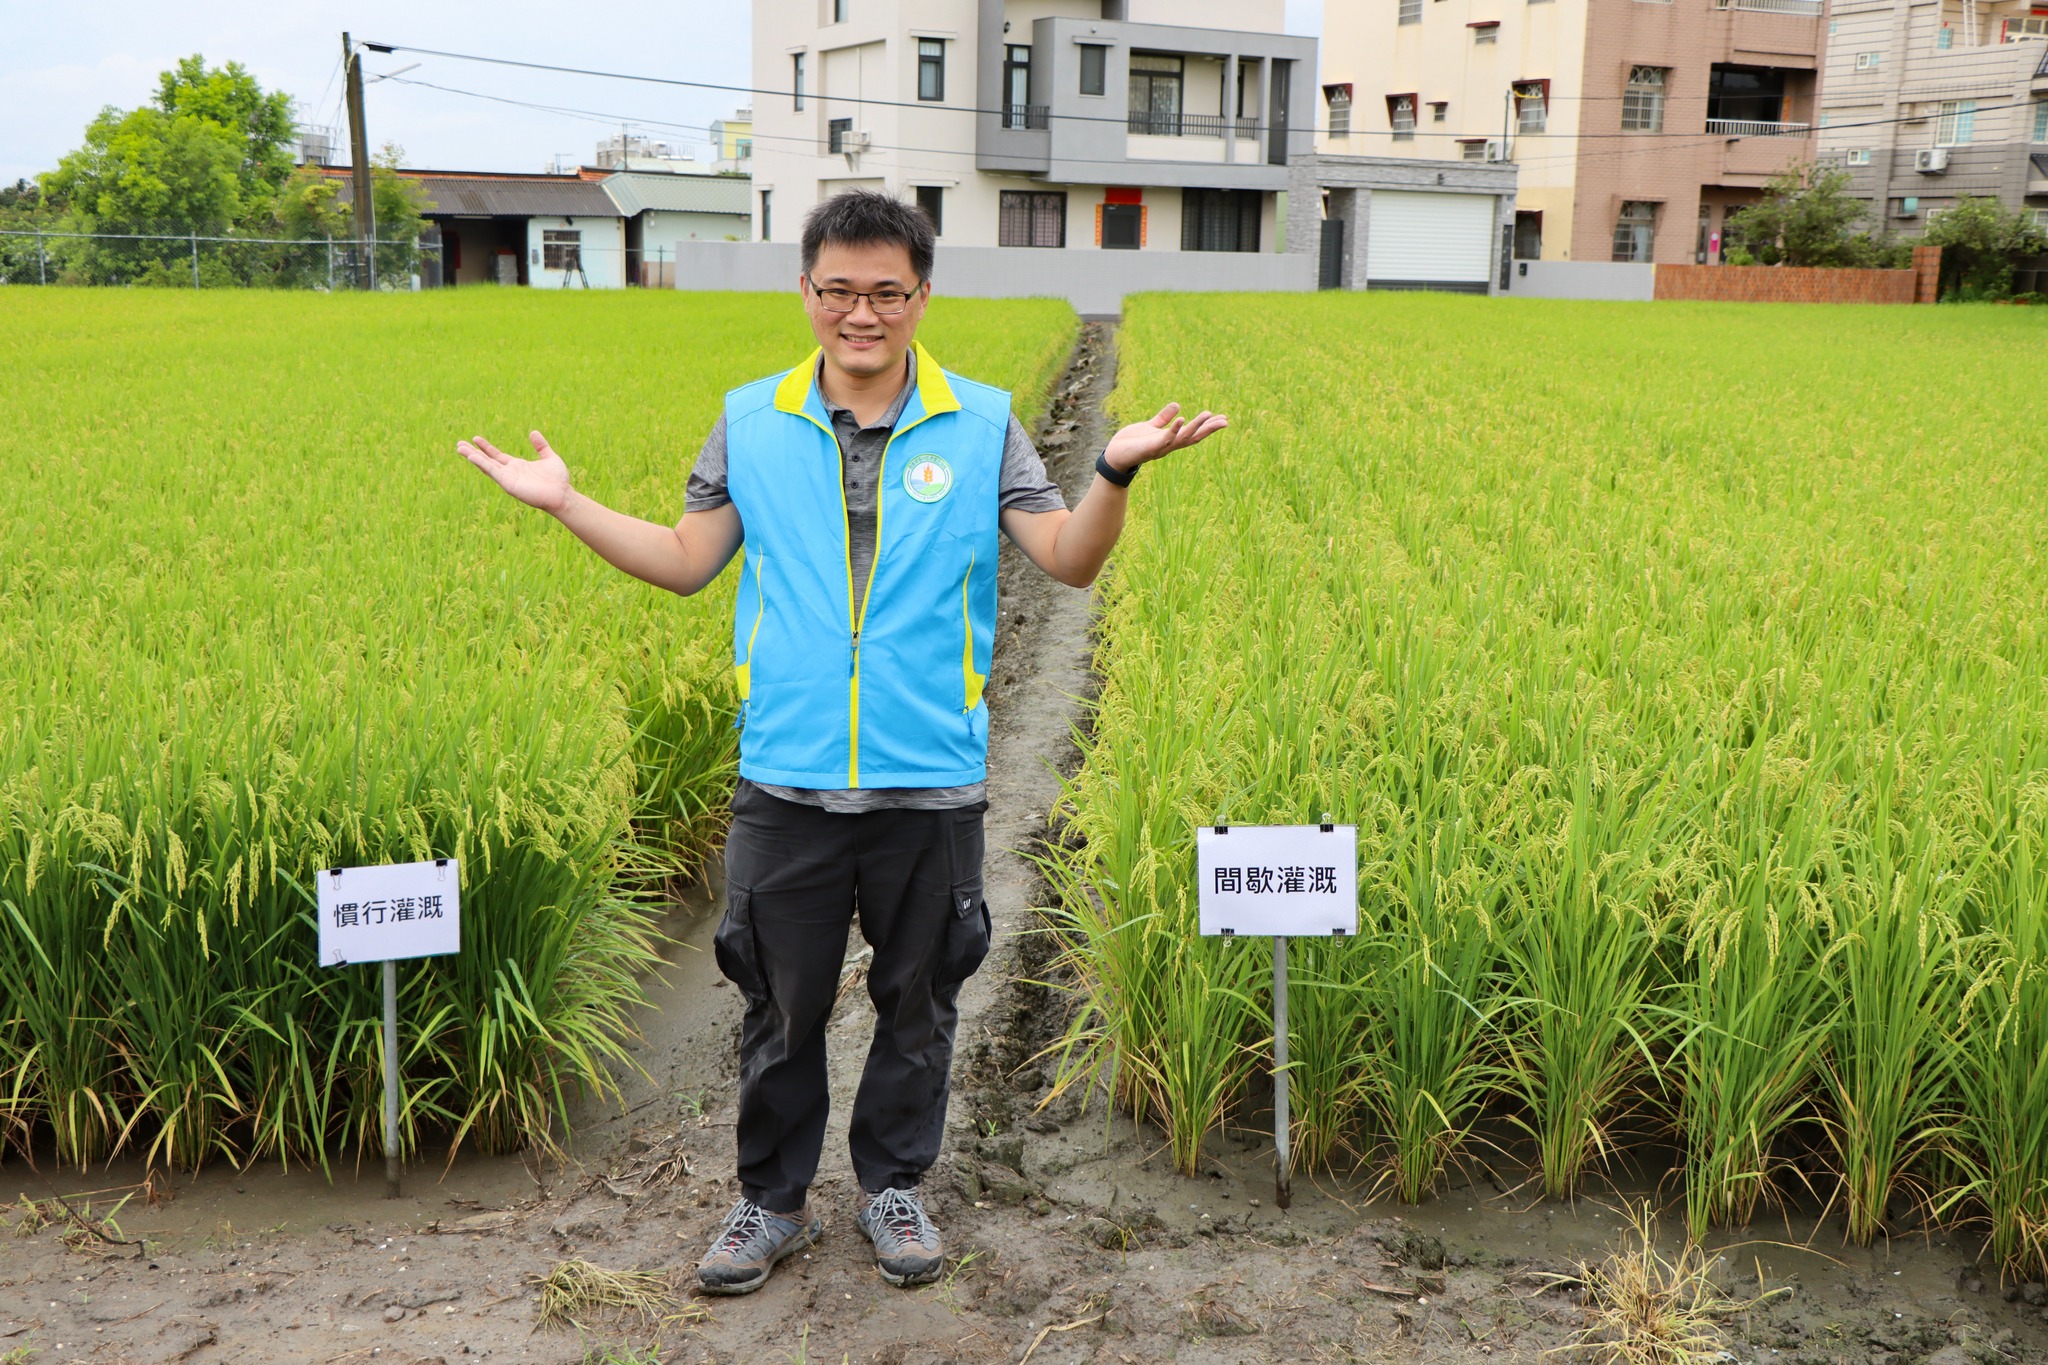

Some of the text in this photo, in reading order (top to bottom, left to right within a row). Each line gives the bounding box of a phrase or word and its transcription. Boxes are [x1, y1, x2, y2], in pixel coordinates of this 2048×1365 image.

[1214, 866, 1337, 895] 間歇灌溉
[333, 895, 443, 928] 慣行灌溉
